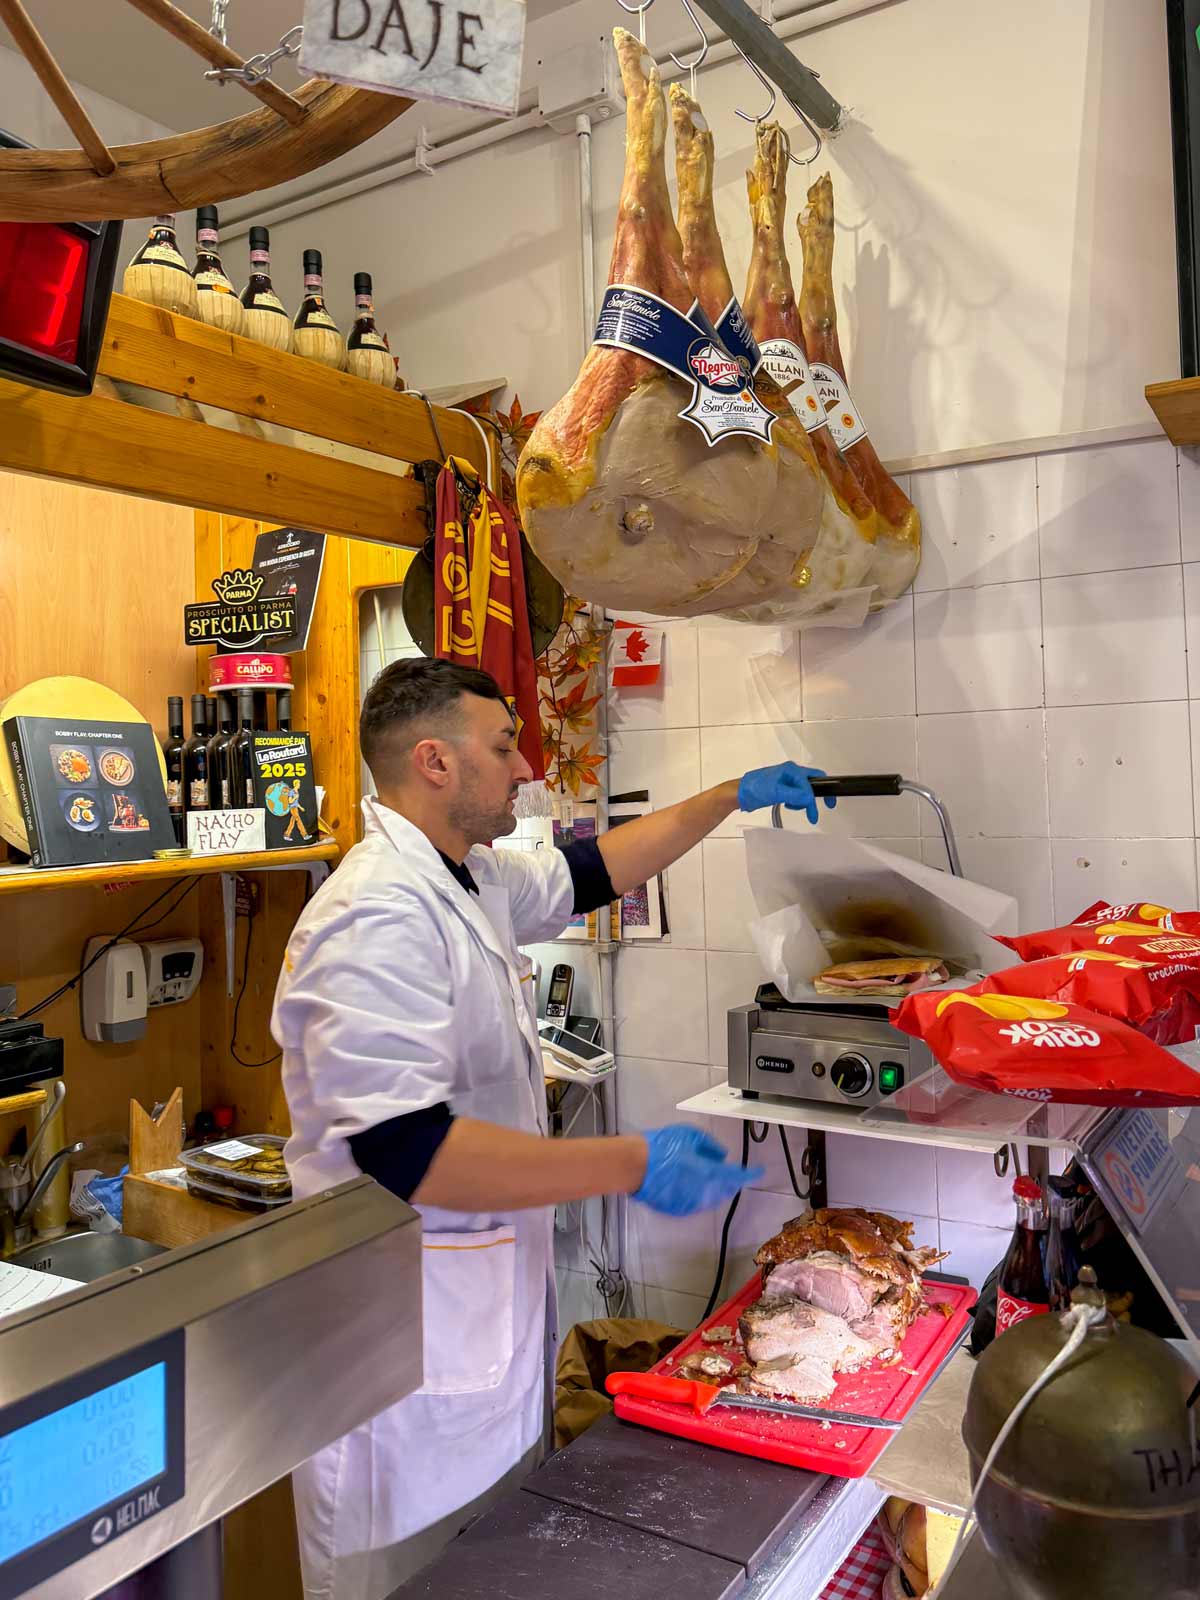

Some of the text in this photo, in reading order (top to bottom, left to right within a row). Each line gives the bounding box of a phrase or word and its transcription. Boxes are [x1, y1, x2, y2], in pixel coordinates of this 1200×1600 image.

[329, 0, 489, 75] DAJE
[606, 294, 662, 321] San Daniele
[701, 400, 760, 414] San Daniele
[226, 590, 252, 600] PARMA
[187, 601, 292, 618] PROSCIUTTO DI PARMA
[189, 610, 294, 637] SPECIALIST
[237, 665, 273, 674] CALLIPO
[255, 736, 305, 746] RECOMMANDÉ PAR
[11, 741, 20, 760] BOBBY
[20, 783, 31, 815] CHAPTER
[260, 763, 307, 778] 2025
[195, 814, 255, 831] NACHO
[199, 830, 244, 850] FLAY
[765, 1061, 788, 1069] HENDI
[1115, 1110, 1154, 1160] VIETATO
[1131, 1132, 1168, 1185] FUMARE
